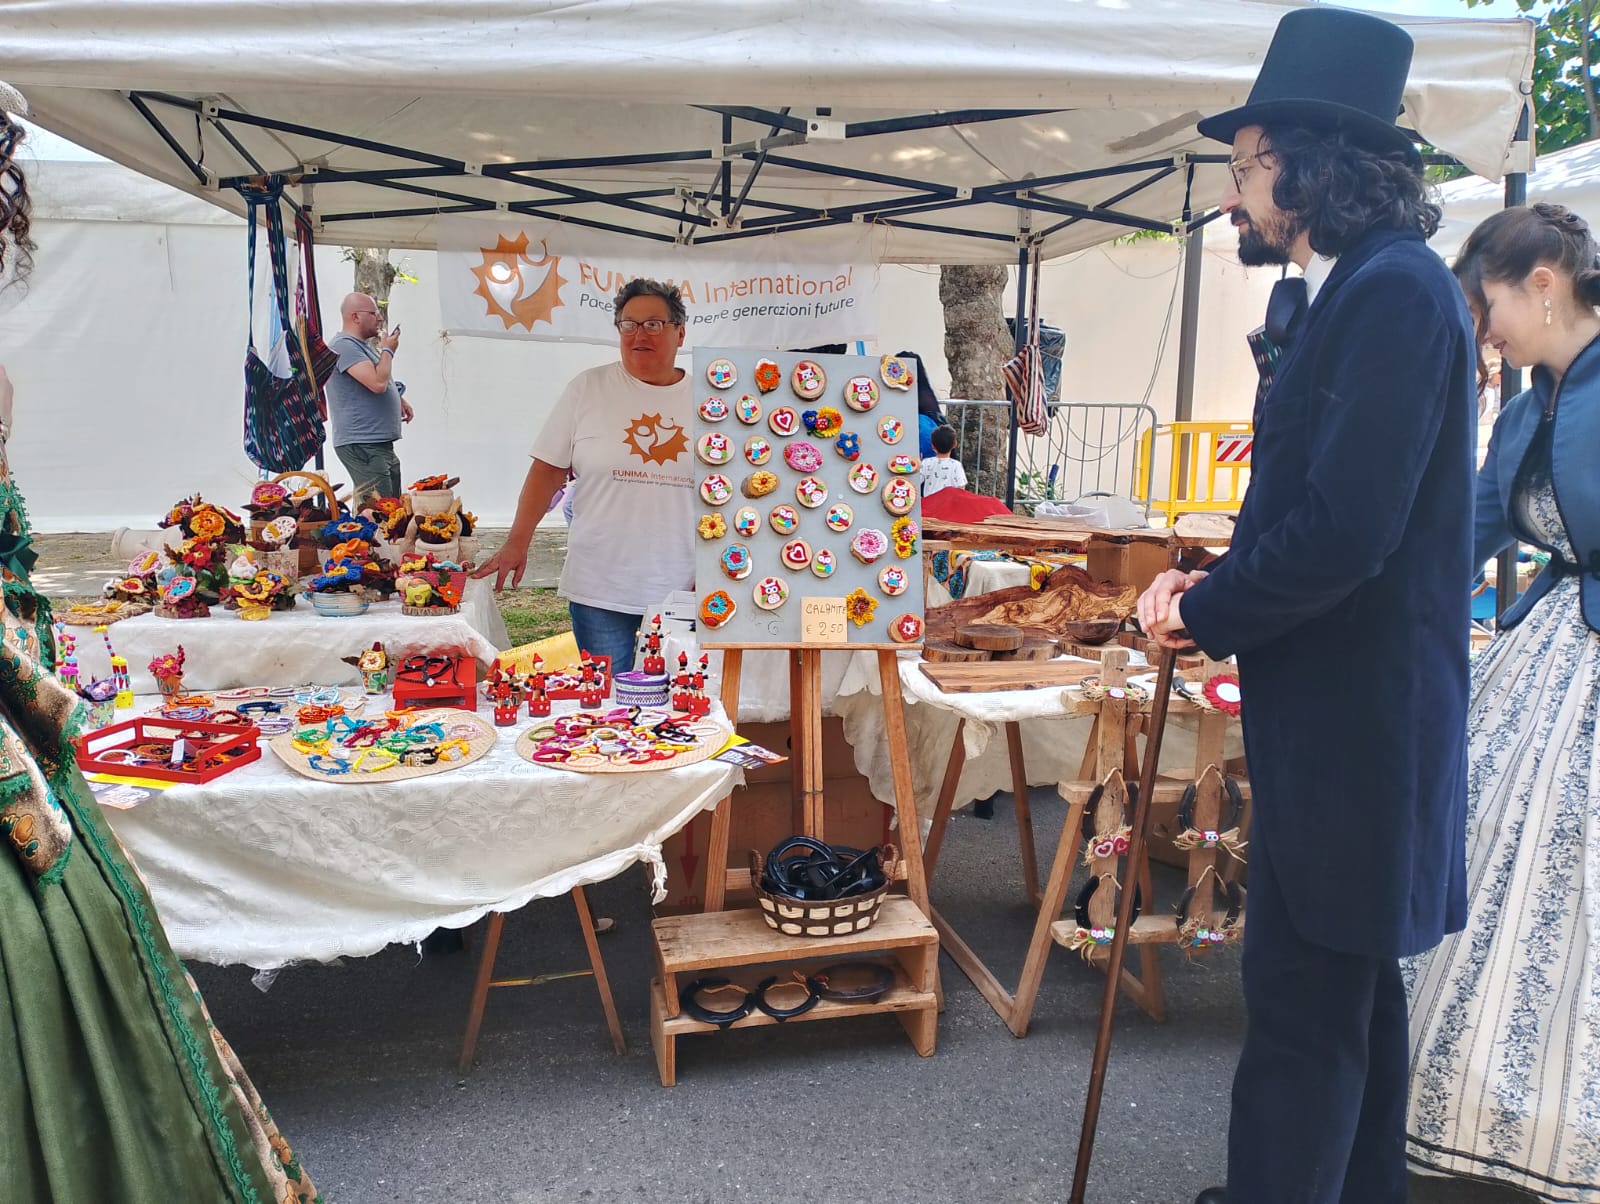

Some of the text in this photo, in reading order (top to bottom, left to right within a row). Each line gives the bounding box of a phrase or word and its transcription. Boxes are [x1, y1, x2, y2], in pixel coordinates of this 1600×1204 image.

[704, 266, 853, 304] International
[814, 297, 854, 319] future
[612, 469, 649, 479] FUNIMA
